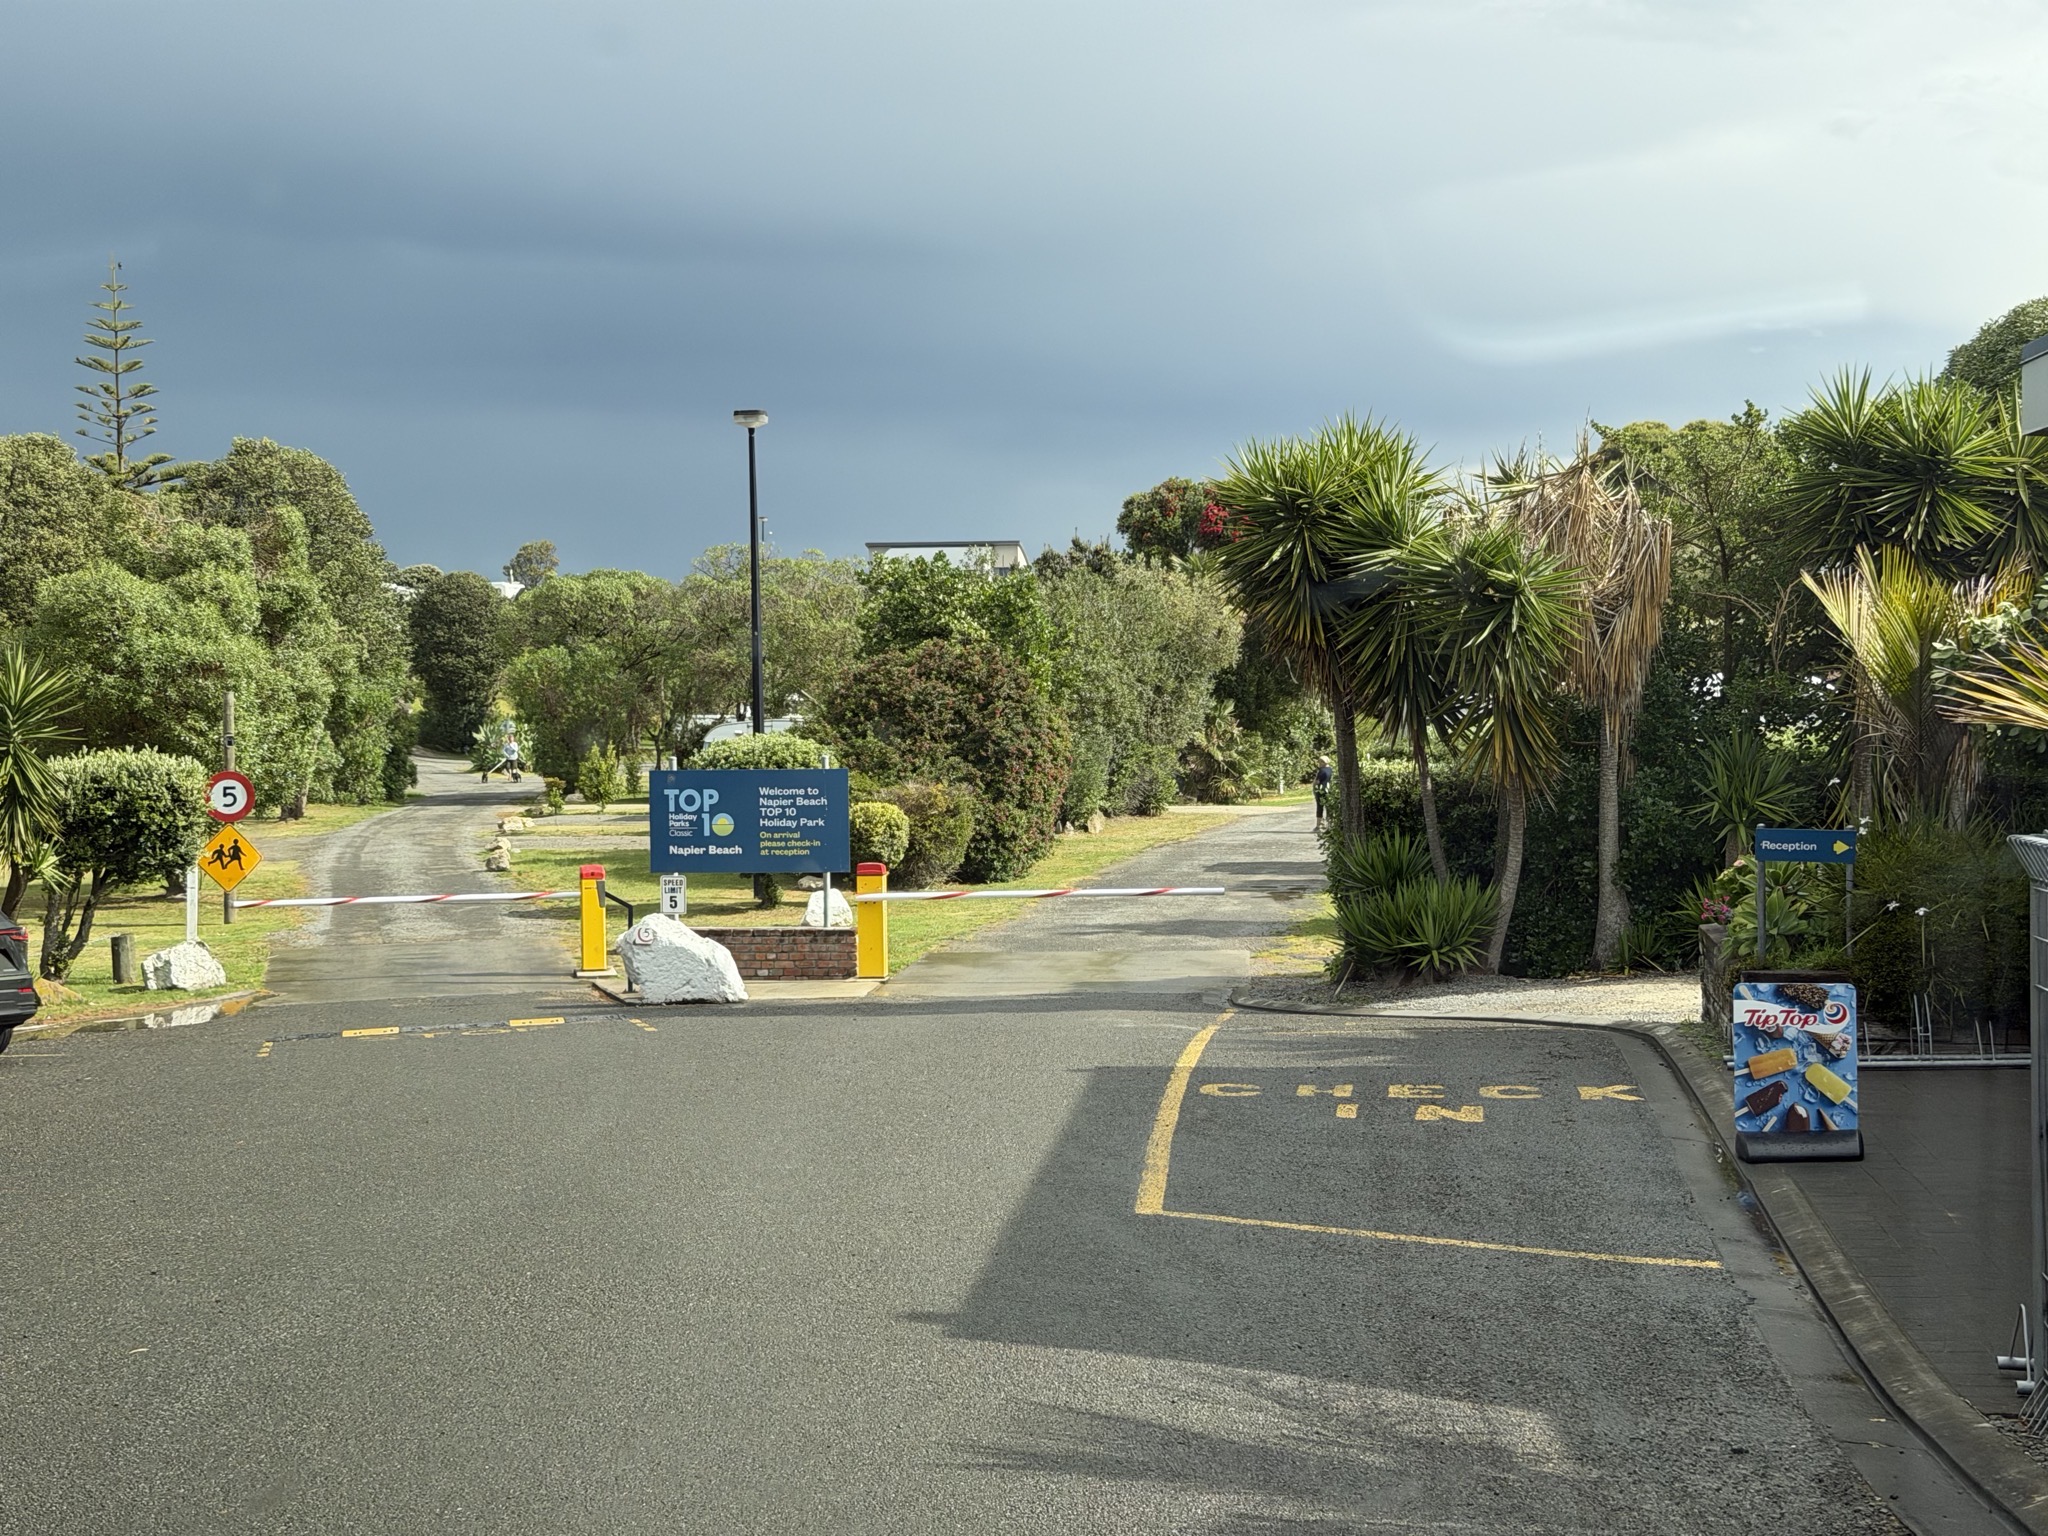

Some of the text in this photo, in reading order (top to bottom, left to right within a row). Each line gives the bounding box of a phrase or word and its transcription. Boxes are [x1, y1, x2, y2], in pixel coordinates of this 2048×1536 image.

[759, 787, 819, 795] Welcome to
[222, 786, 237, 807] 5
[664, 788, 719, 812] TOP
[759, 797, 828, 807] Napier Beach
[669, 813, 697, 821] Holiday
[759, 808, 797, 816] TOP 10
[701, 813, 734, 836] 10
[759, 818, 825, 828] Holiday Park
[759, 831, 801, 839] On arrival
[760, 840, 786, 849] please
[1761, 841, 1817, 852] Reception
[669, 845, 743, 857] Napier Beach
[771, 849, 810, 857] reception
[663, 879, 684, 887] SPEED
[664, 886, 683, 895] LIMIT
[669, 895, 678, 909] 5
[1744, 1009, 1818, 1029] Tip Top
[1199, 1083, 1644, 1101] CHECK
[1335, 1103, 1485, 1122] IN
